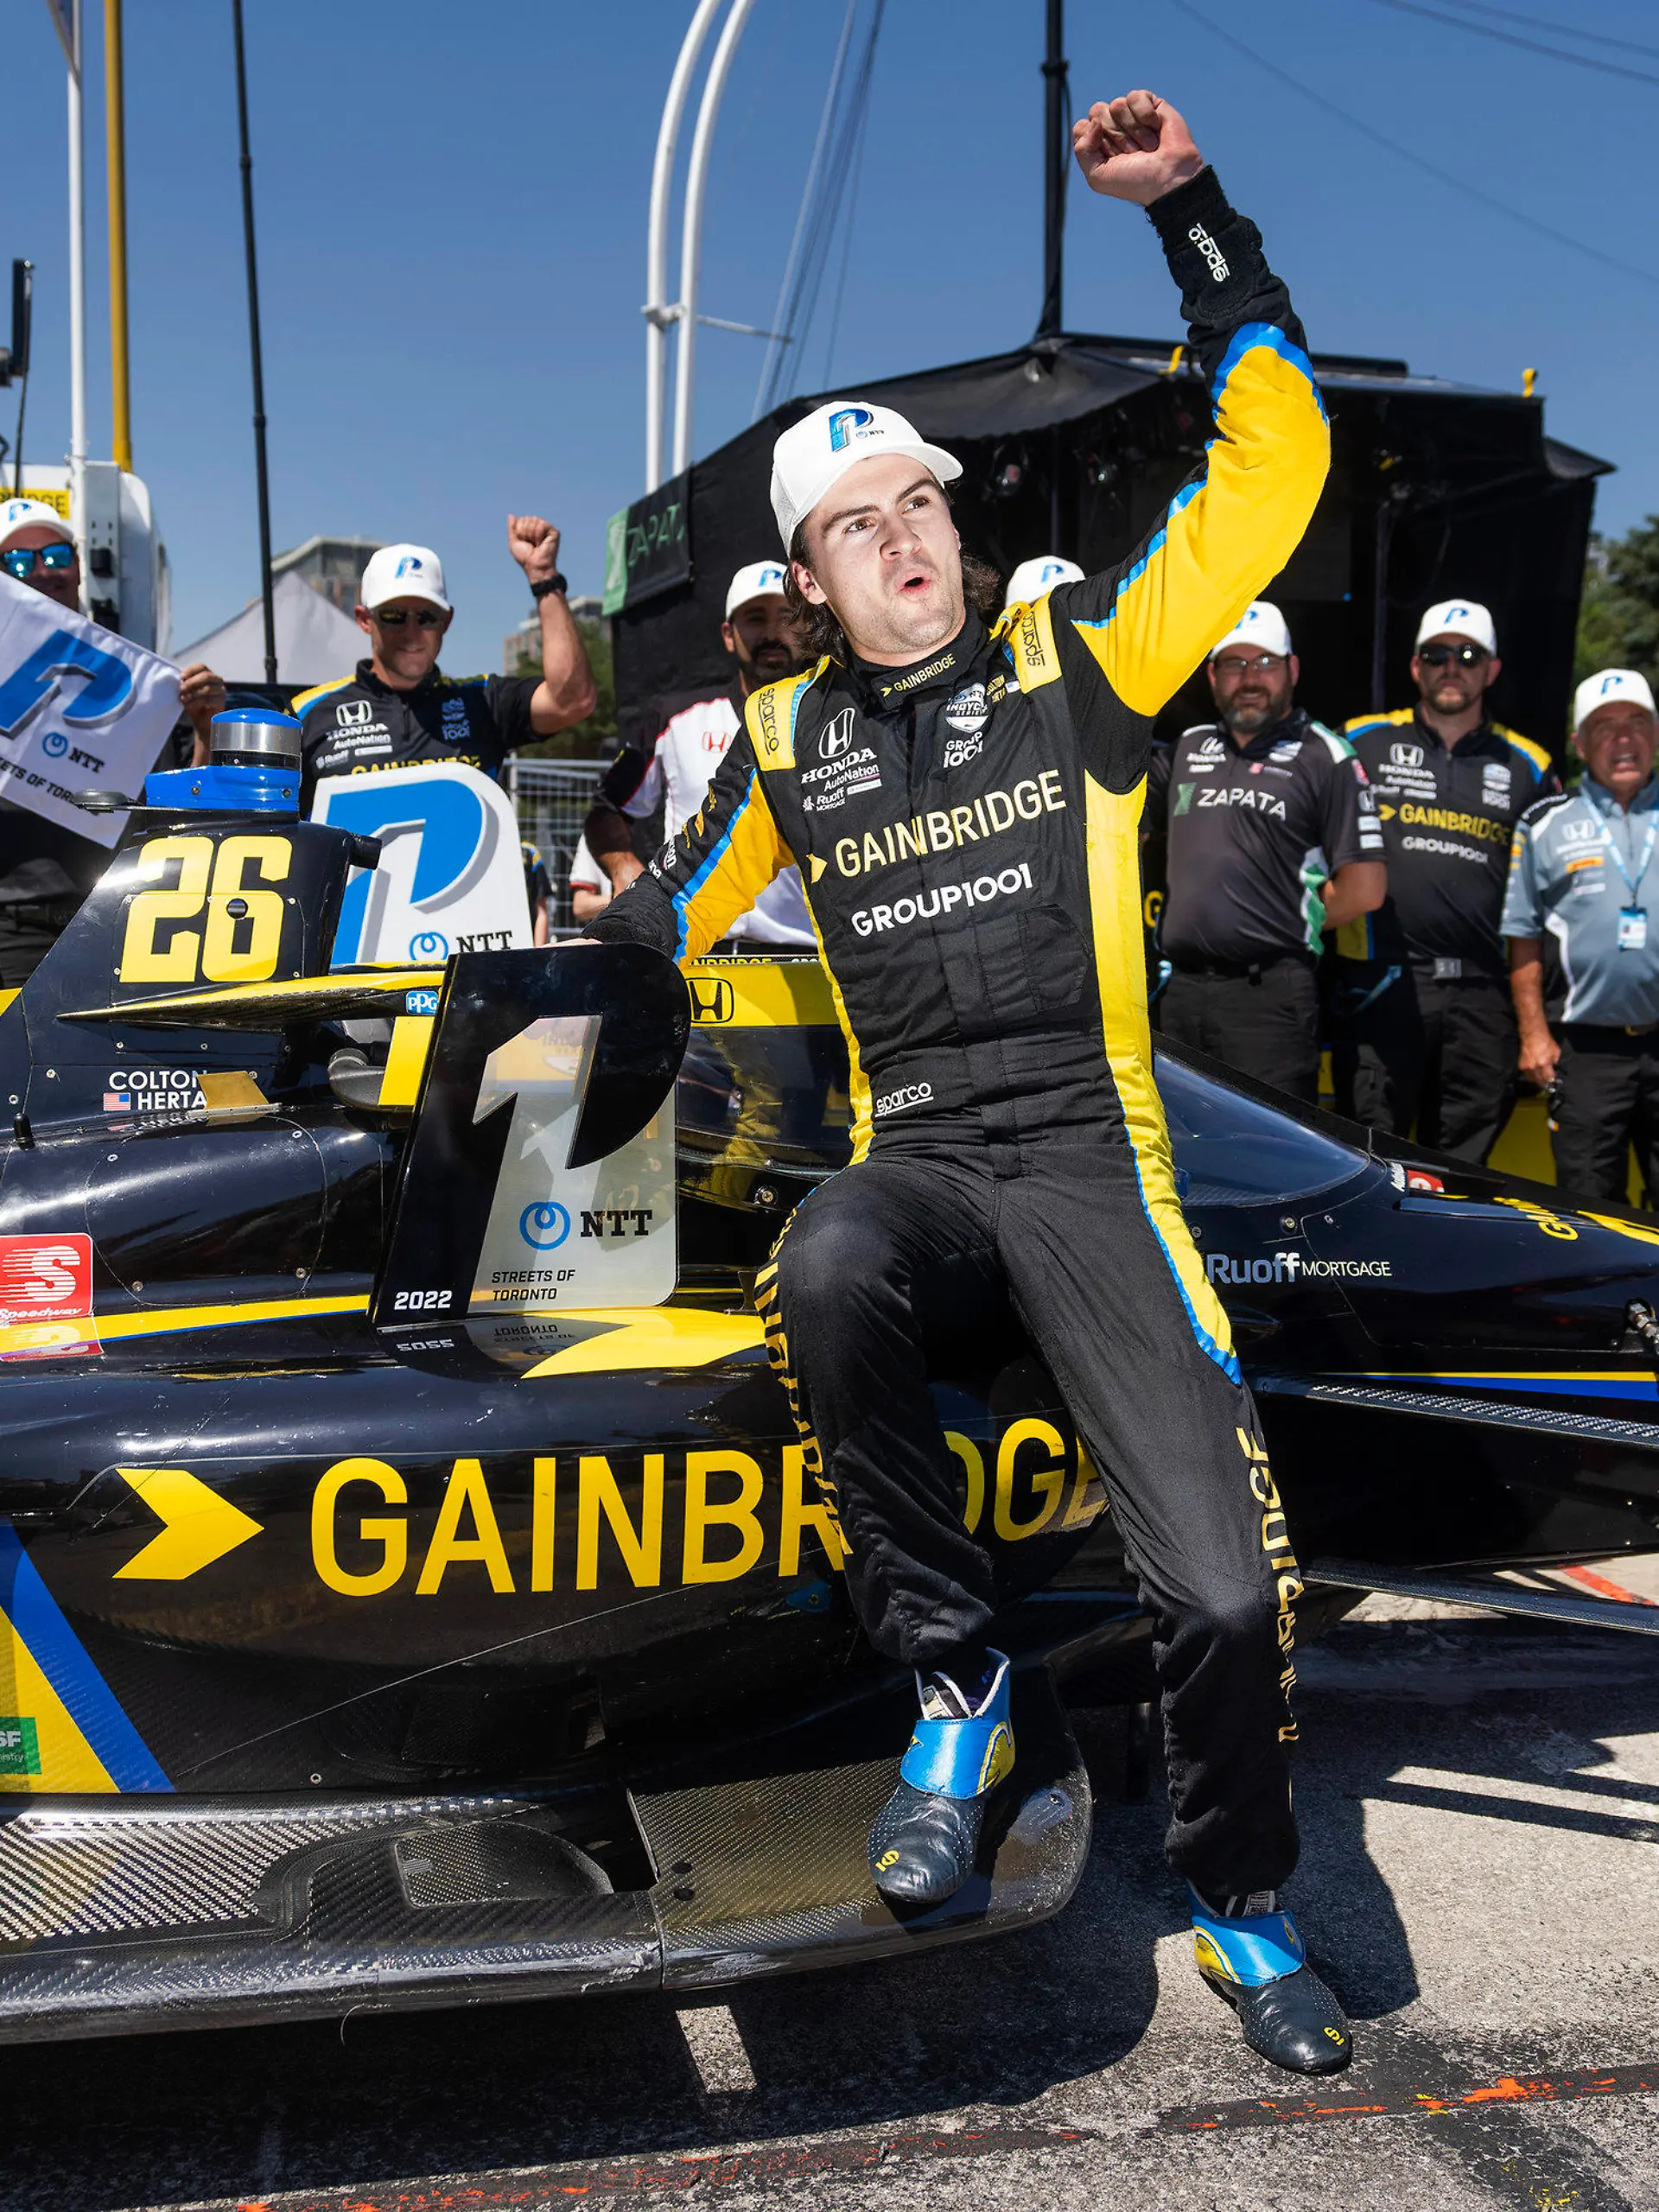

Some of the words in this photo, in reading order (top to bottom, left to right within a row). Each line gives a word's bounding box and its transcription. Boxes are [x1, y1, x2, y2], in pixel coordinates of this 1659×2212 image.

[1189, 225, 1229, 282] spao
[893, 653, 957, 692] GAINBRIDGE
[760, 688, 779, 753] sparco
[946, 701, 988, 712] INDYC
[68, 747, 105, 773] NTT
[801, 747, 877, 784] HONDA
[944, 741, 983, 768] 1001
[0, 757, 27, 779] ETS
[26, 773, 47, 787] OF
[823, 764, 880, 792] AutoNation
[817, 786, 844, 805] Ruoff
[1197, 788, 1287, 822] ZAPATA
[835, 769, 1066, 878] GAINBRIDGE
[1399, 803, 1511, 846] GAINBRIDGE
[1402, 836, 1489, 864] GROUP1001
[119, 836, 293, 982] 26
[851, 863, 1033, 937] GROUP1001
[456, 931, 512, 952] NTT
[408, 993, 438, 1014] PPG
[137, 1090, 207, 1109] HERTA
[876, 1082, 932, 1116] sparco
[580, 1210, 652, 1237] NTT
[492, 1270, 553, 1284] STREETS
[556, 1269, 576, 1281] OF
[1206, 1252, 1300, 1284] Ruoff
[1302, 1261, 1392, 1277] MORTGAGE
[394, 1290, 453, 1310] 2022
[493, 1287, 557, 1301] TORONTO
[0, 1307, 83, 1320] Speedway
[312, 1417, 1109, 1597] GAINBRGE
